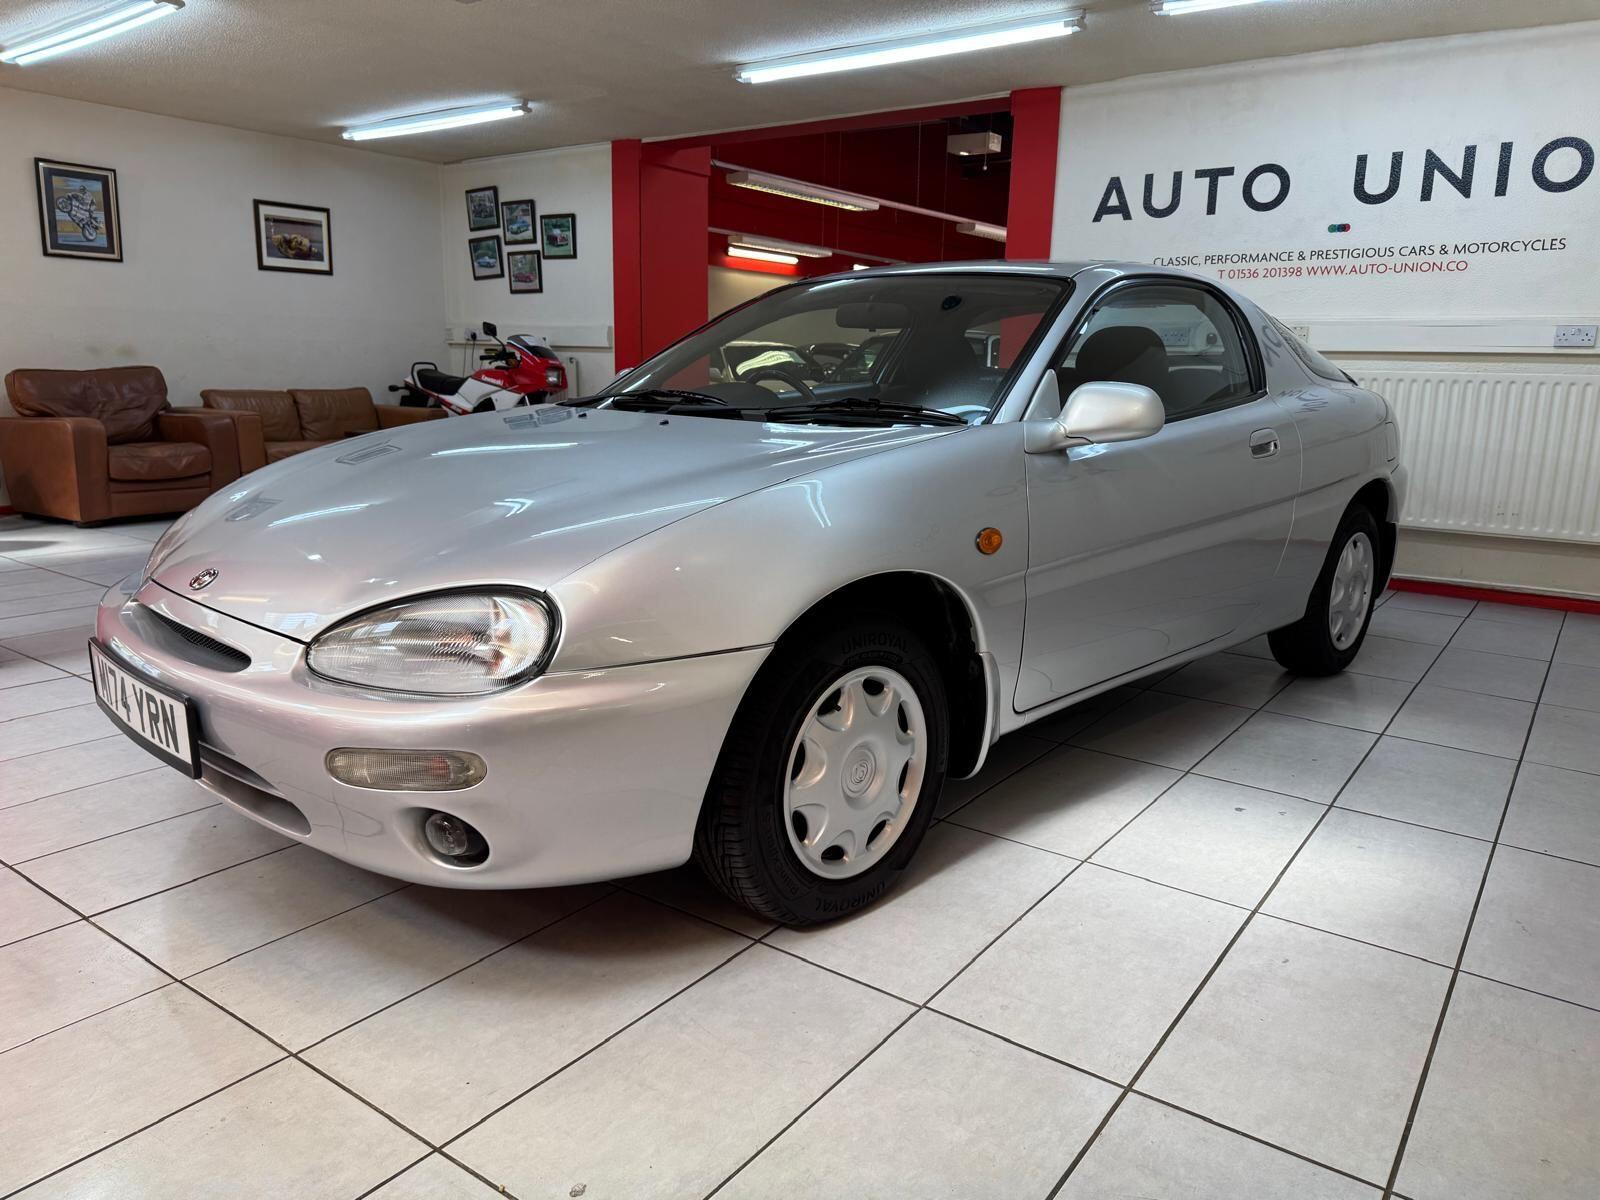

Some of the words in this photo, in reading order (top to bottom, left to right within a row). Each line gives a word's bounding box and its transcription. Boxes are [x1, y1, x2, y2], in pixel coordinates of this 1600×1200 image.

[1092, 163, 1291, 223] AUTO
[1353, 136, 1595, 205] UNIO
[1153, 255, 1201, 267] CLASSIC,
[1204, 251, 1294, 265] PERFORMANCE
[1297, 250, 1306, 261] &
[1309, 246, 1395, 260] PRESTIGIOUS
[1399, 245, 1435, 257] CARS
[1439, 244, 1449, 255] &
[1453, 238, 1567, 255] MOTORCYCLES
[1218, 269, 1226, 279] T
[1228, 268, 1259, 279] 01536
[1262, 267, 1302, 279] 201398
[1306, 260, 1468, 276] WWW.AUTO-UNION.CO
[841, 631, 908, 654] UNIROYAL
[132, 683, 180, 754] YRN
